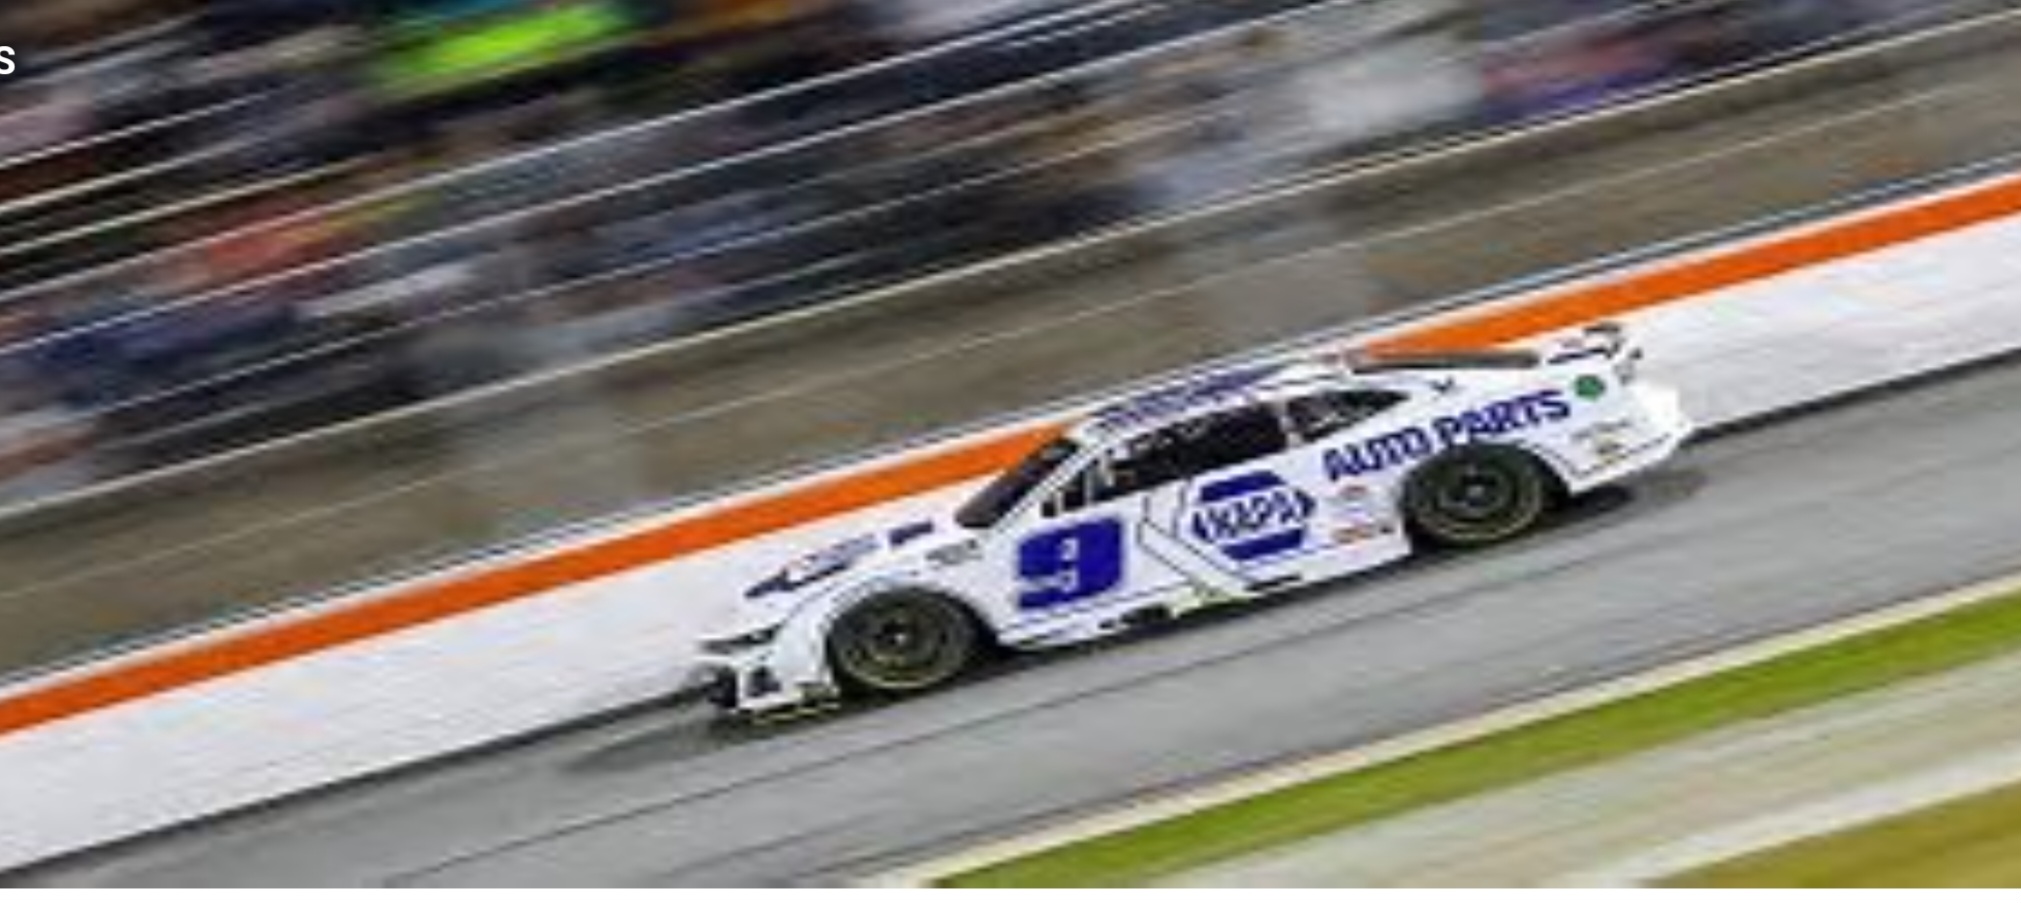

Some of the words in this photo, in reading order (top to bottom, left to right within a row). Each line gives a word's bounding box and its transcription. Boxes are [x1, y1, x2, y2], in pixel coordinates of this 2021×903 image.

[1323, 427, 1431, 481] AUTO
[1432, 389, 1571, 441] PARTS
[1207, 486, 1303, 539] NAPA
[1018, 515, 1122, 609] 9
